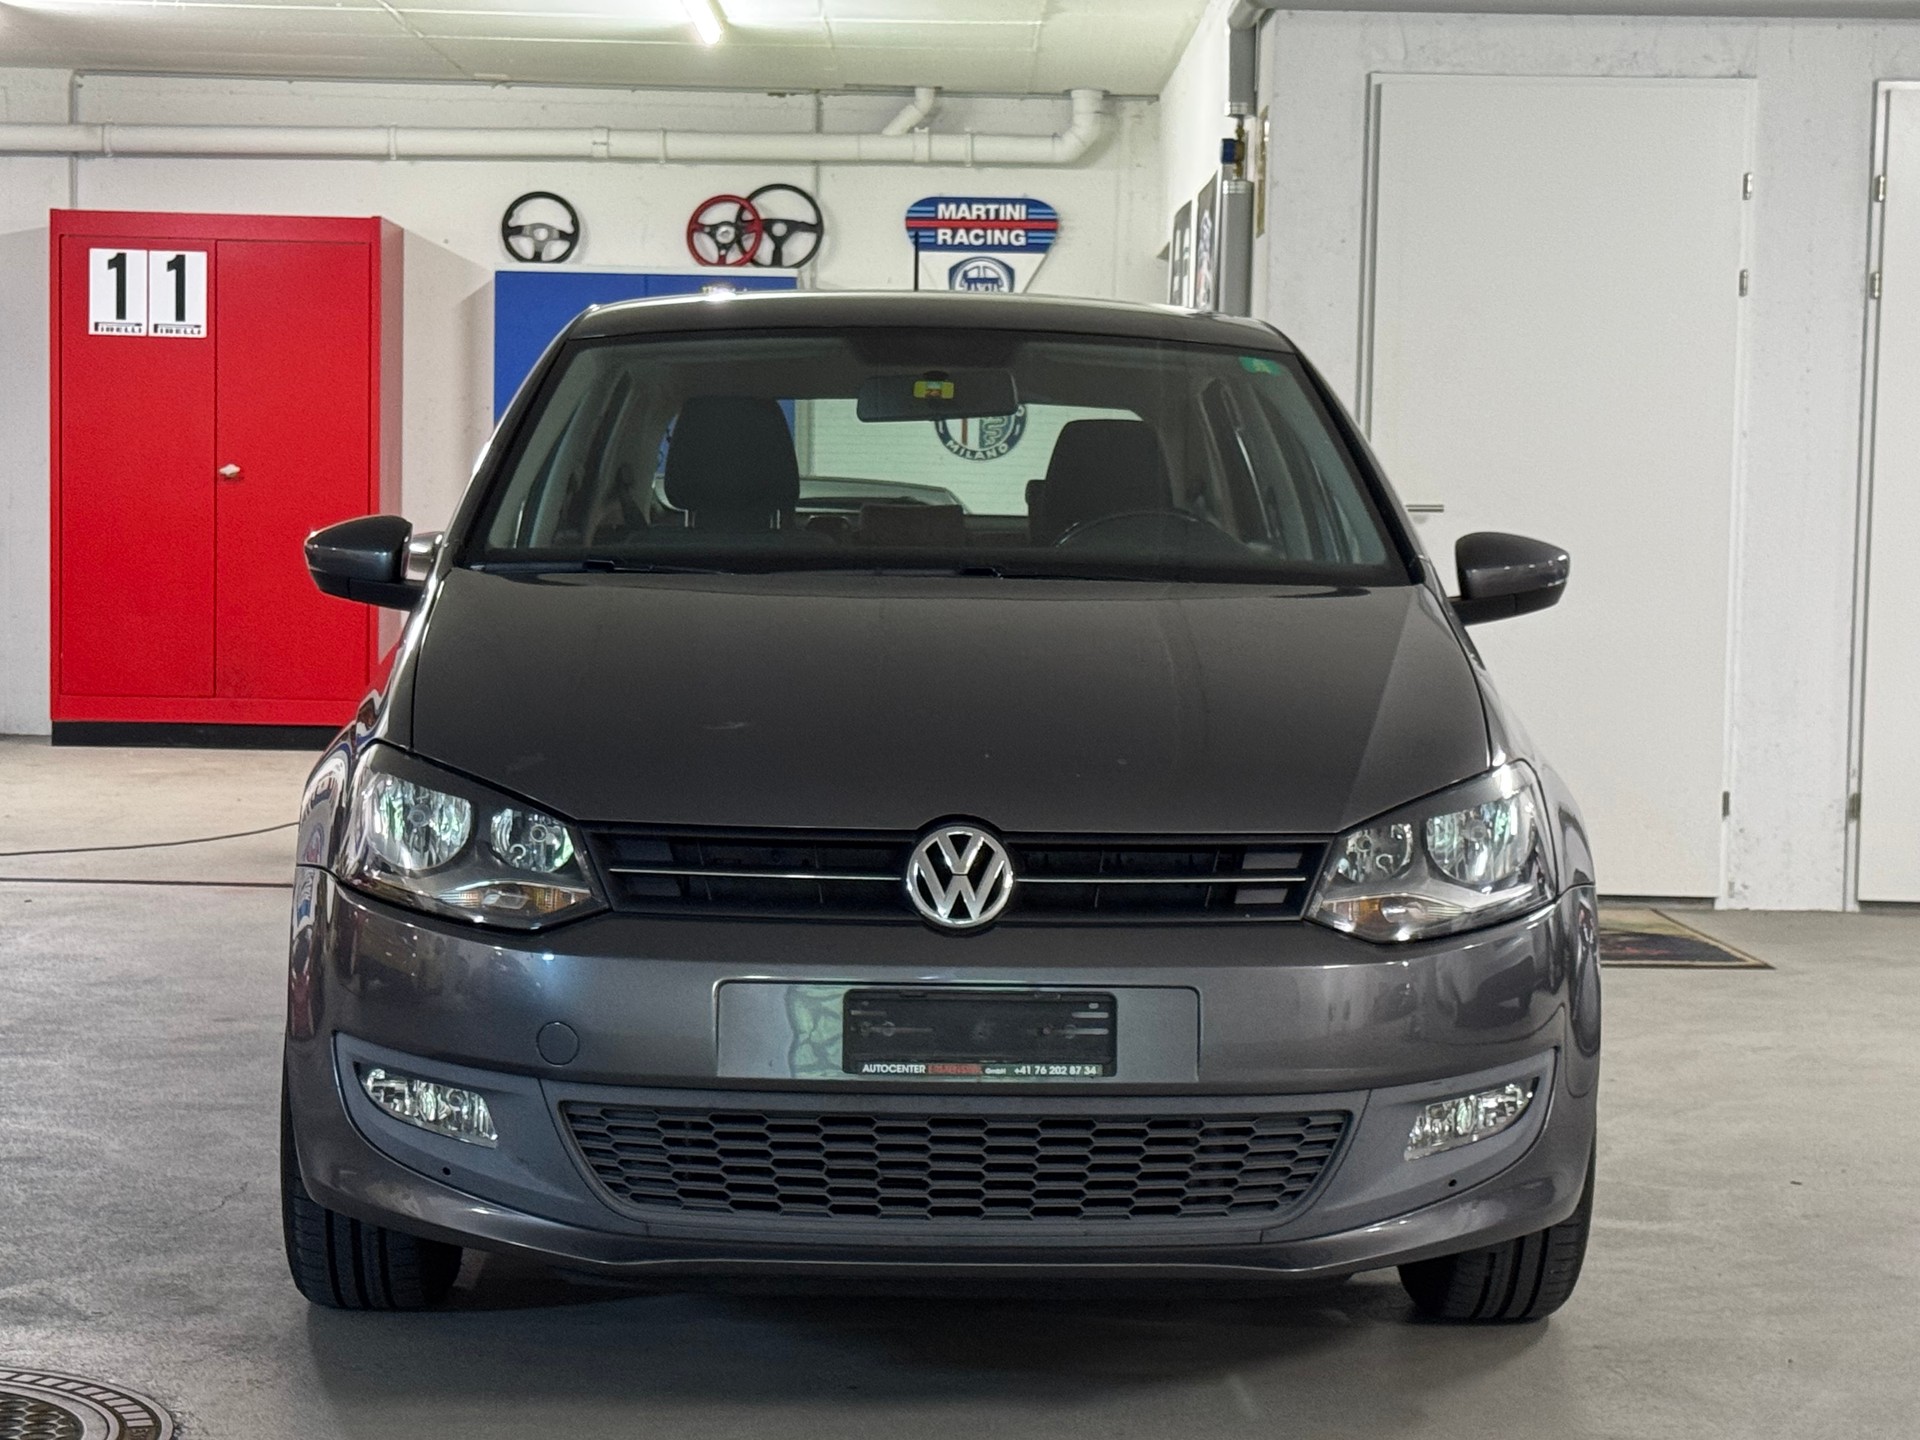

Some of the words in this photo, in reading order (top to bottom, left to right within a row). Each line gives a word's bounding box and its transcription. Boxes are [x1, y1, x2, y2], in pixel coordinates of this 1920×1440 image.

[936, 203, 1027, 221] MARTINI
[936, 229, 1027, 246] RACING
[946, 440, 1009, 460] MILANO
[907, 826, 1012, 928] VW
[862, 1064, 926, 1074] AUTOCENTER
[1034, 1065, 1047, 1076] 76
[1048, 1065, 1068, 1076] 202
[1069, 1066, 1082, 1076] 87
[1083, 1066, 1097, 1076] 34
